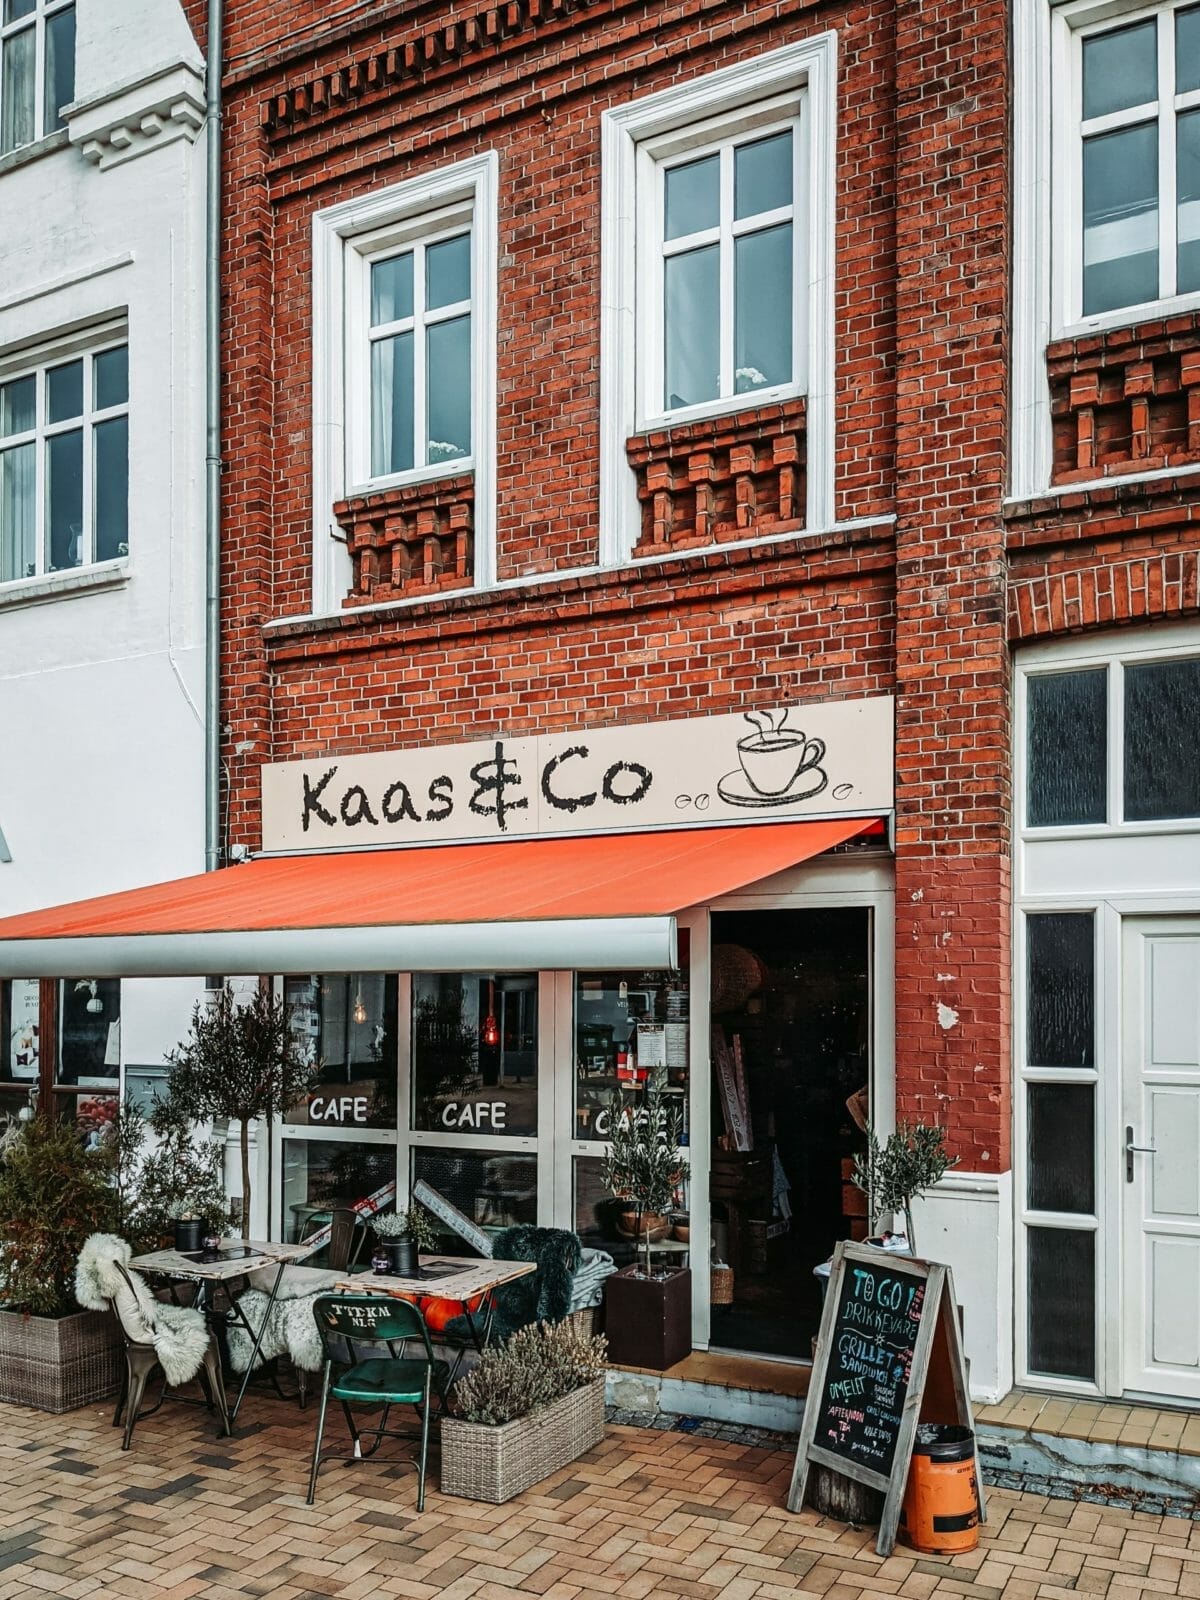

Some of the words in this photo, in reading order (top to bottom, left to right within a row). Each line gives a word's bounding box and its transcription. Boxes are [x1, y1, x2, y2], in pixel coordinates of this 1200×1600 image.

[301, 766, 454, 832] Kaas
[541, 745, 653, 813] Co
[309, 1096, 368, 1122] CAFE
[442, 1102, 507, 1128] CAFE
[853, 1269, 875, 1302] TO
[839, 1334, 895, 1369] GRILLET
[840, 1355, 889, 1385] SANDWICH
